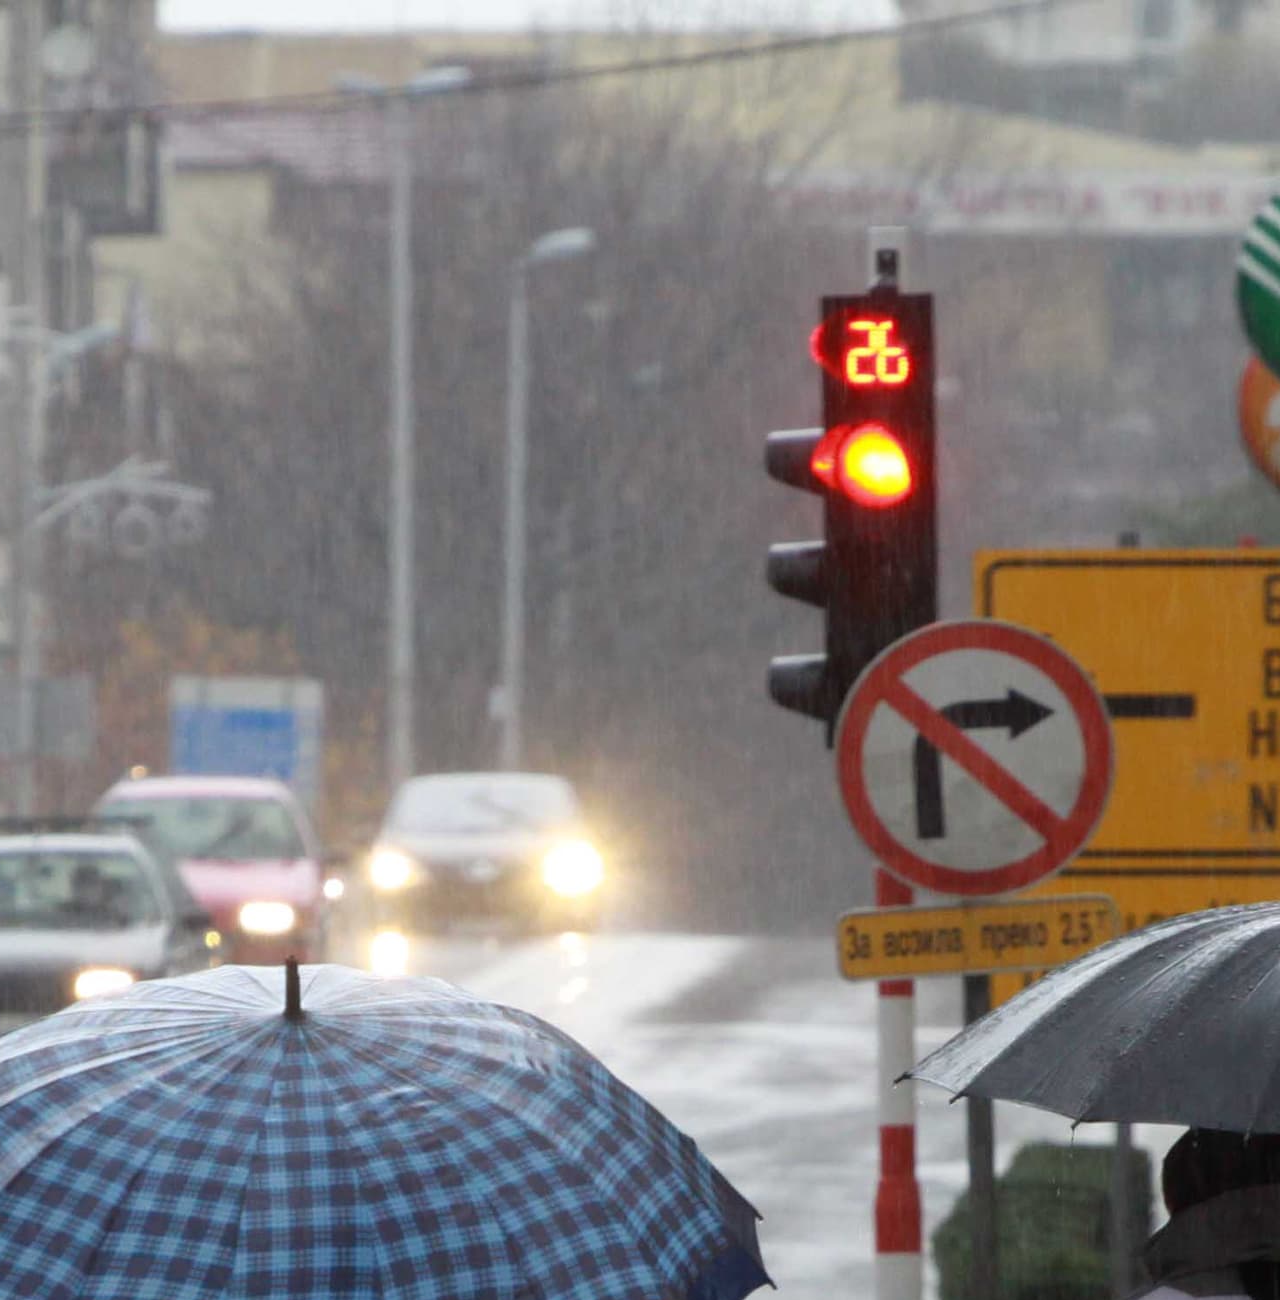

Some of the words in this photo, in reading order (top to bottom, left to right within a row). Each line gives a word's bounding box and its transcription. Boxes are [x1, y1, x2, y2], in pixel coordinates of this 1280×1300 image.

[846, 924, 871, 960] За
[883, 926, 963, 958] возила
[980, 920, 1049, 960] преко
